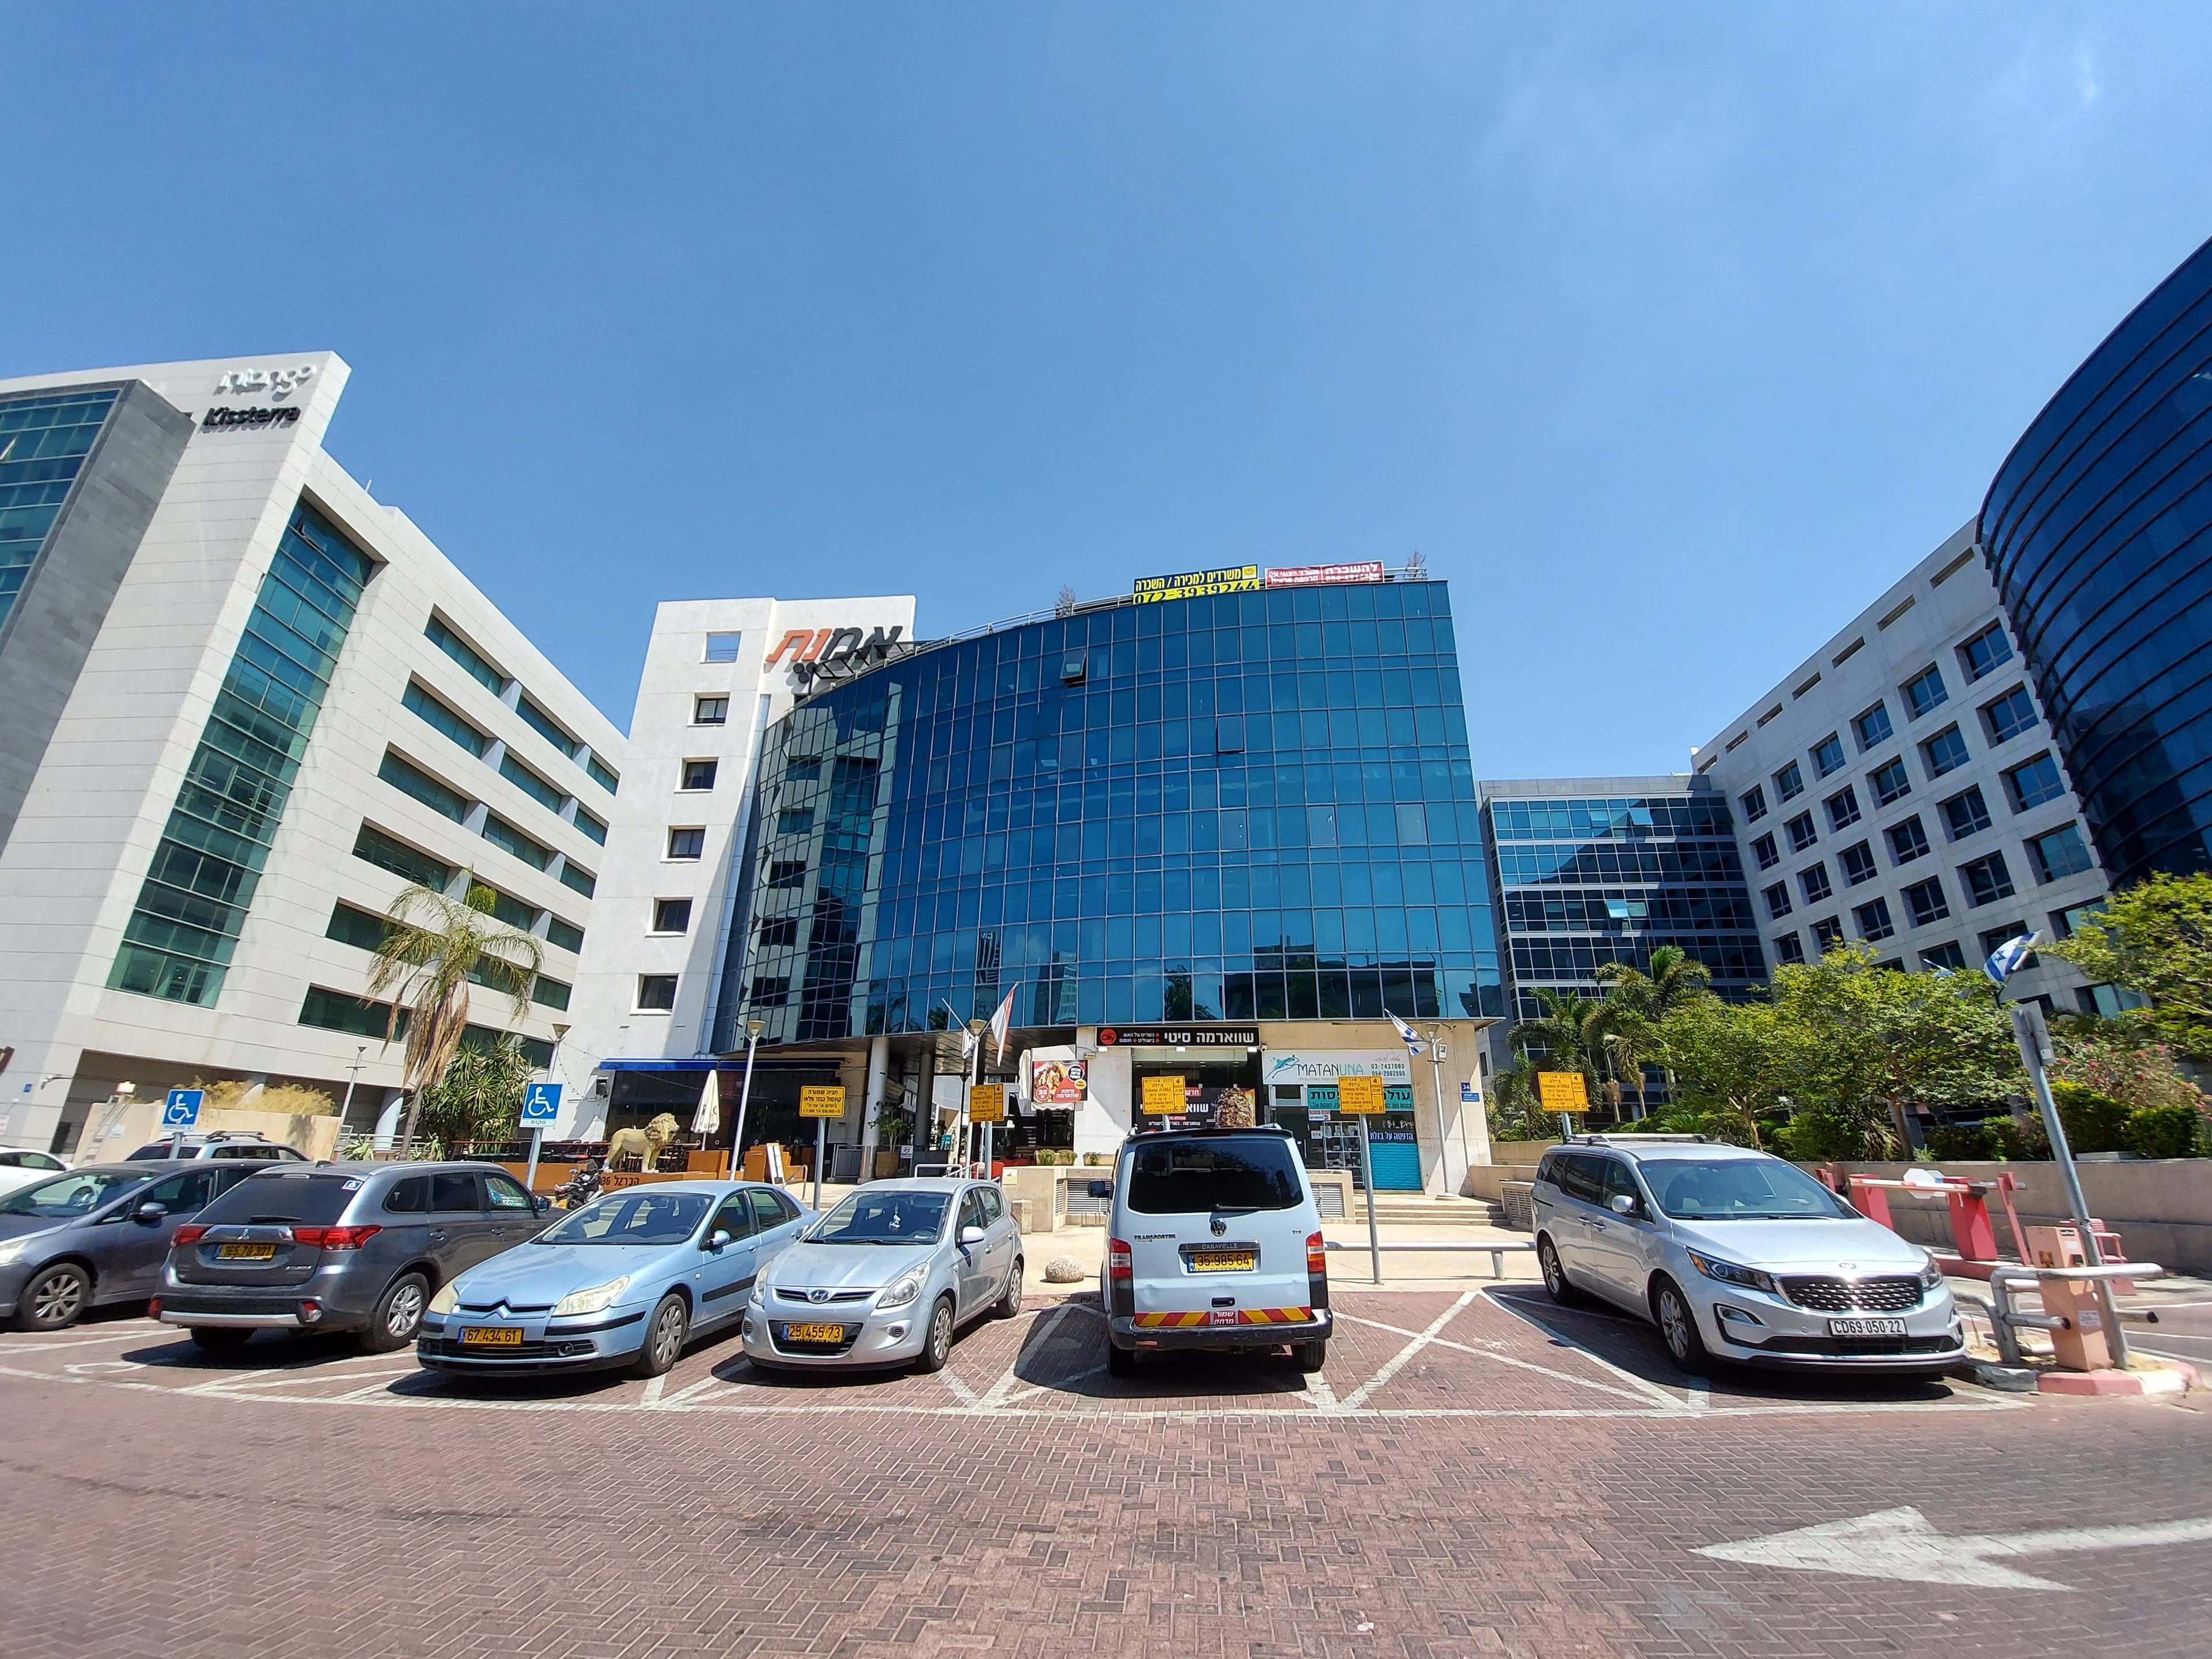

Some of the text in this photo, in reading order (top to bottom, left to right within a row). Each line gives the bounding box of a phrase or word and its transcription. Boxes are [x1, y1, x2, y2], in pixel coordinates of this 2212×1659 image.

[1325, 563, 1378, 575] להשכרה
[1174, 571, 1205, 586] למכירה
[1207, 569, 1241, 583] משרדים
[1135, 578, 1165, 592] השכרה
[1164, 1033, 1254, 1043] שווארמה סיטי
[1297, 1063, 1364, 1076] MATANUNA
